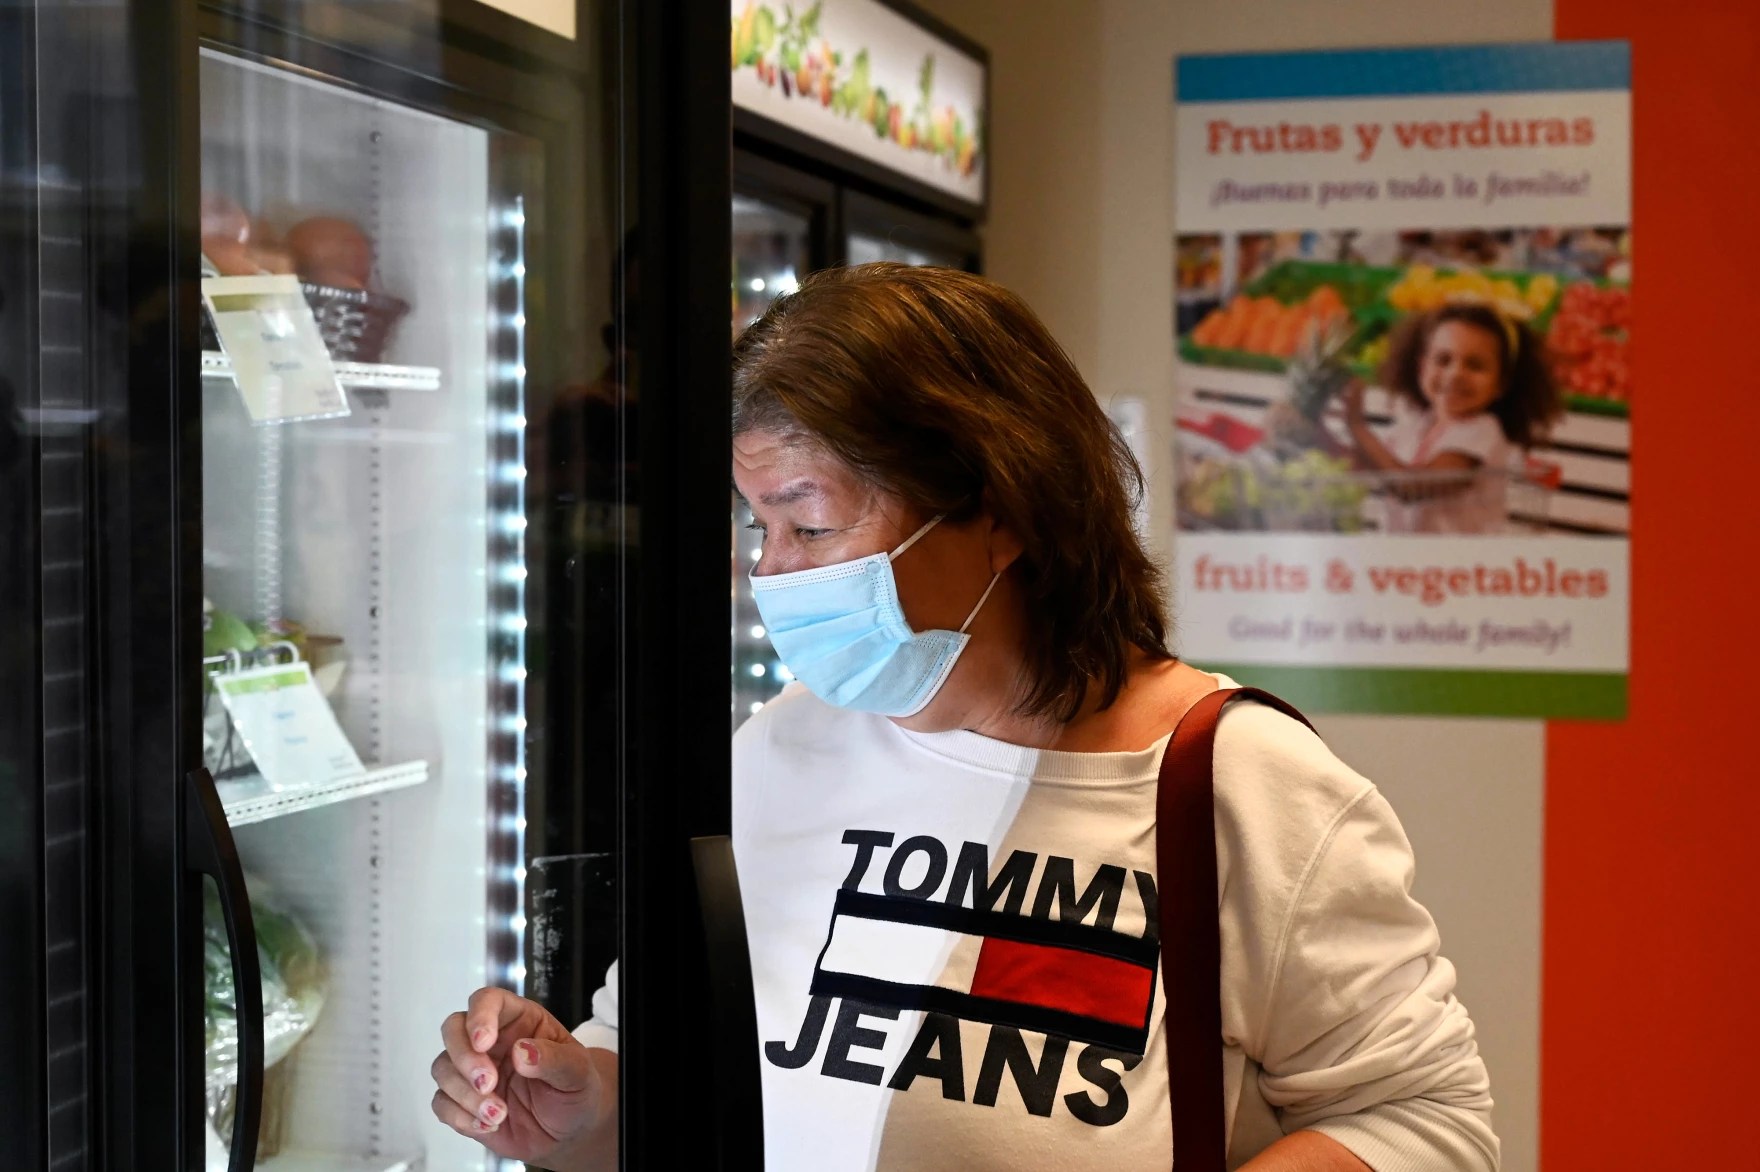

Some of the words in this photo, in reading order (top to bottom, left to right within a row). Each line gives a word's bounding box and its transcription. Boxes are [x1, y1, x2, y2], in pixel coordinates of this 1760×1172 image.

[1205, 119, 1342, 154] Frutas
[1355, 121, 1382, 162] y
[1393, 109, 1596, 149] verduras
[1318, 179, 1378, 208] para
[1388, 174, 1445, 201] toda
[1453, 172, 1480, 197] la
[1193, 554, 1309, 593] fruits
[1325, 558, 1355, 595] &
[1368, 556, 1609, 606] vegetables
[1228, 616, 1294, 642] Good
[1300, 616, 1335, 650] for
[1344, 616, 1385, 644] the
[1393, 618, 1471, 647] whole
[1476, 618, 1573, 655] family!
[764, 995, 1144, 1128] JEANS
